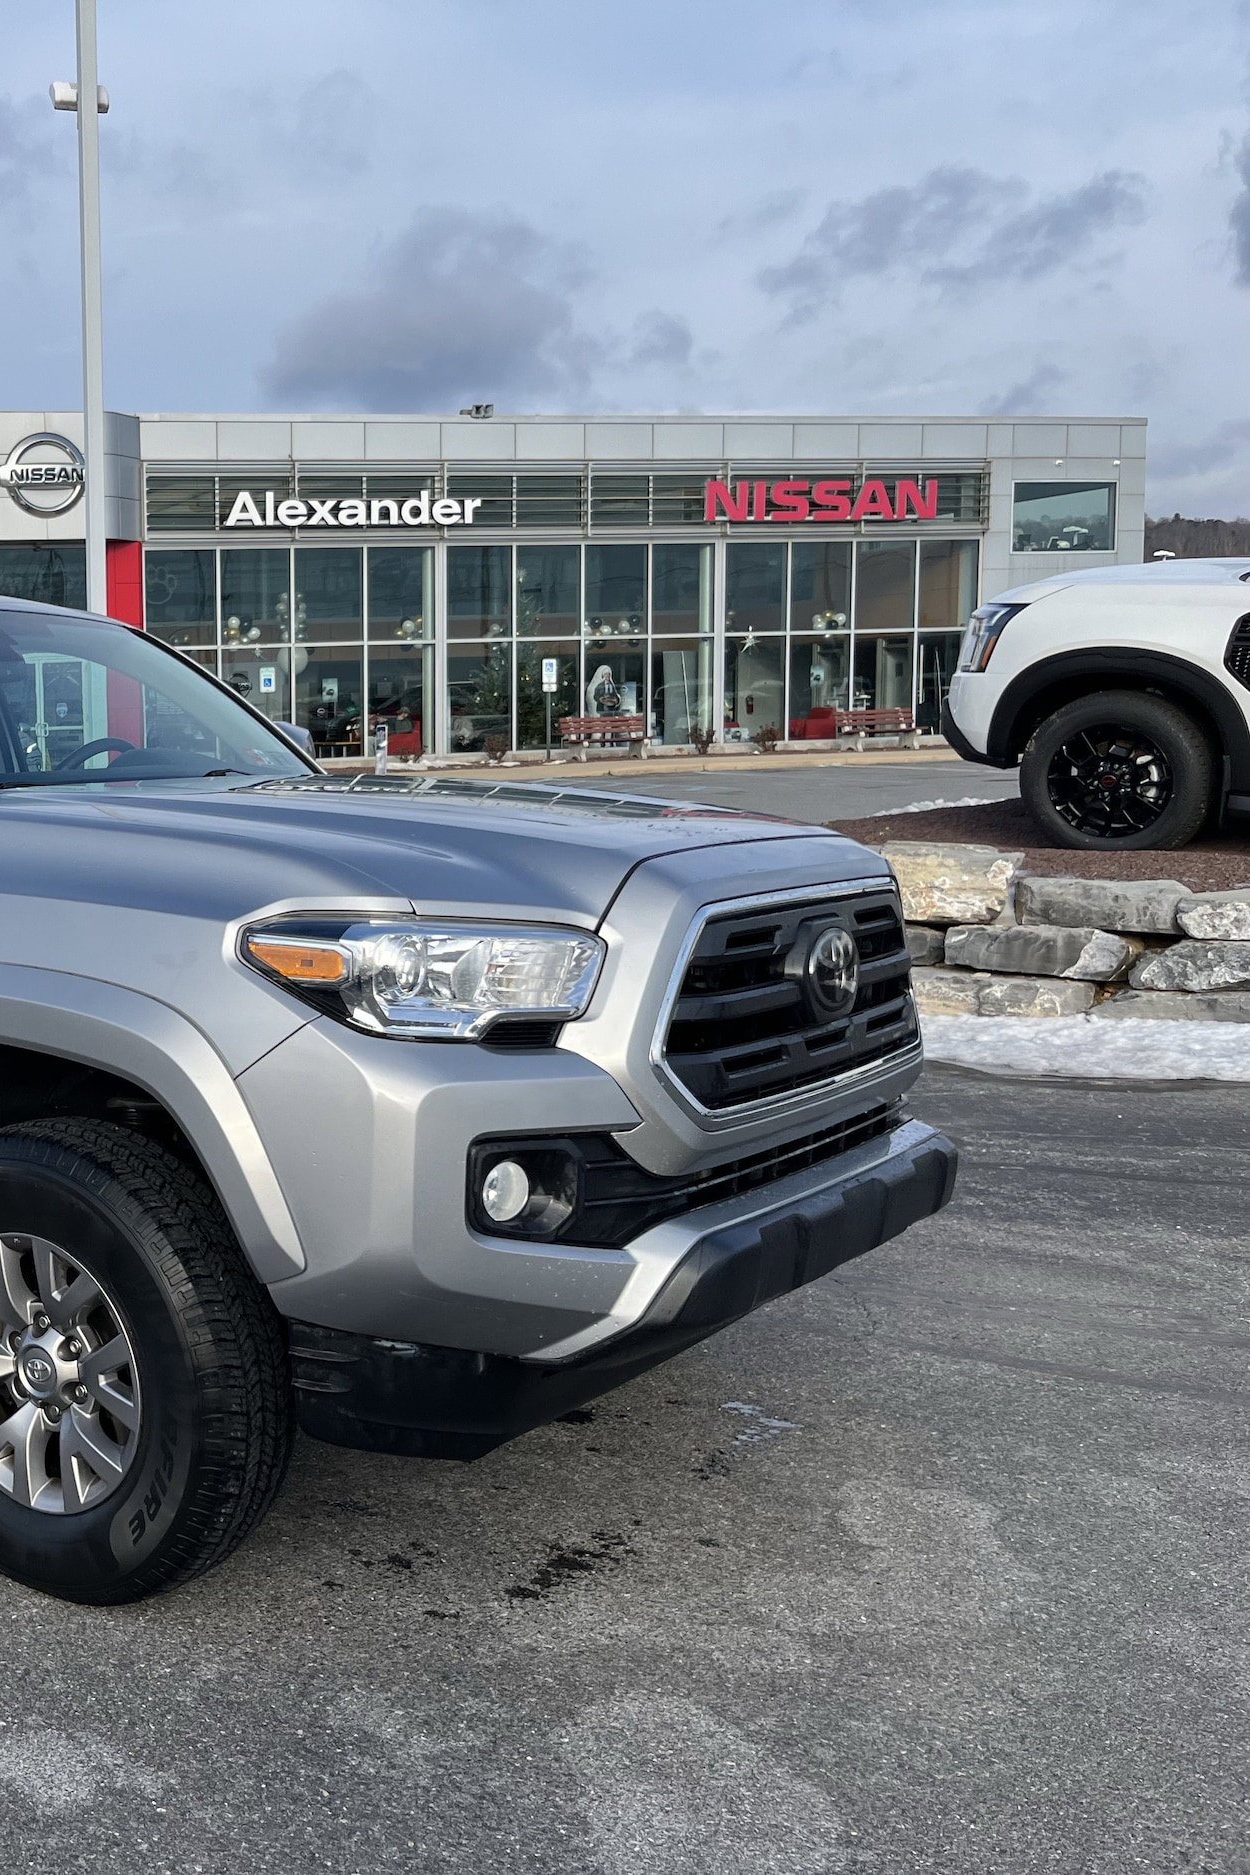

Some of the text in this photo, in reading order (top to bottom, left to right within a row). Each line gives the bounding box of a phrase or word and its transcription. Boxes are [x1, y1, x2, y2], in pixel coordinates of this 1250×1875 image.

[9, 467, 84, 482] NISSAN
[223, 490, 482, 527] Alexander
[704, 479, 938, 522] NISSAN
